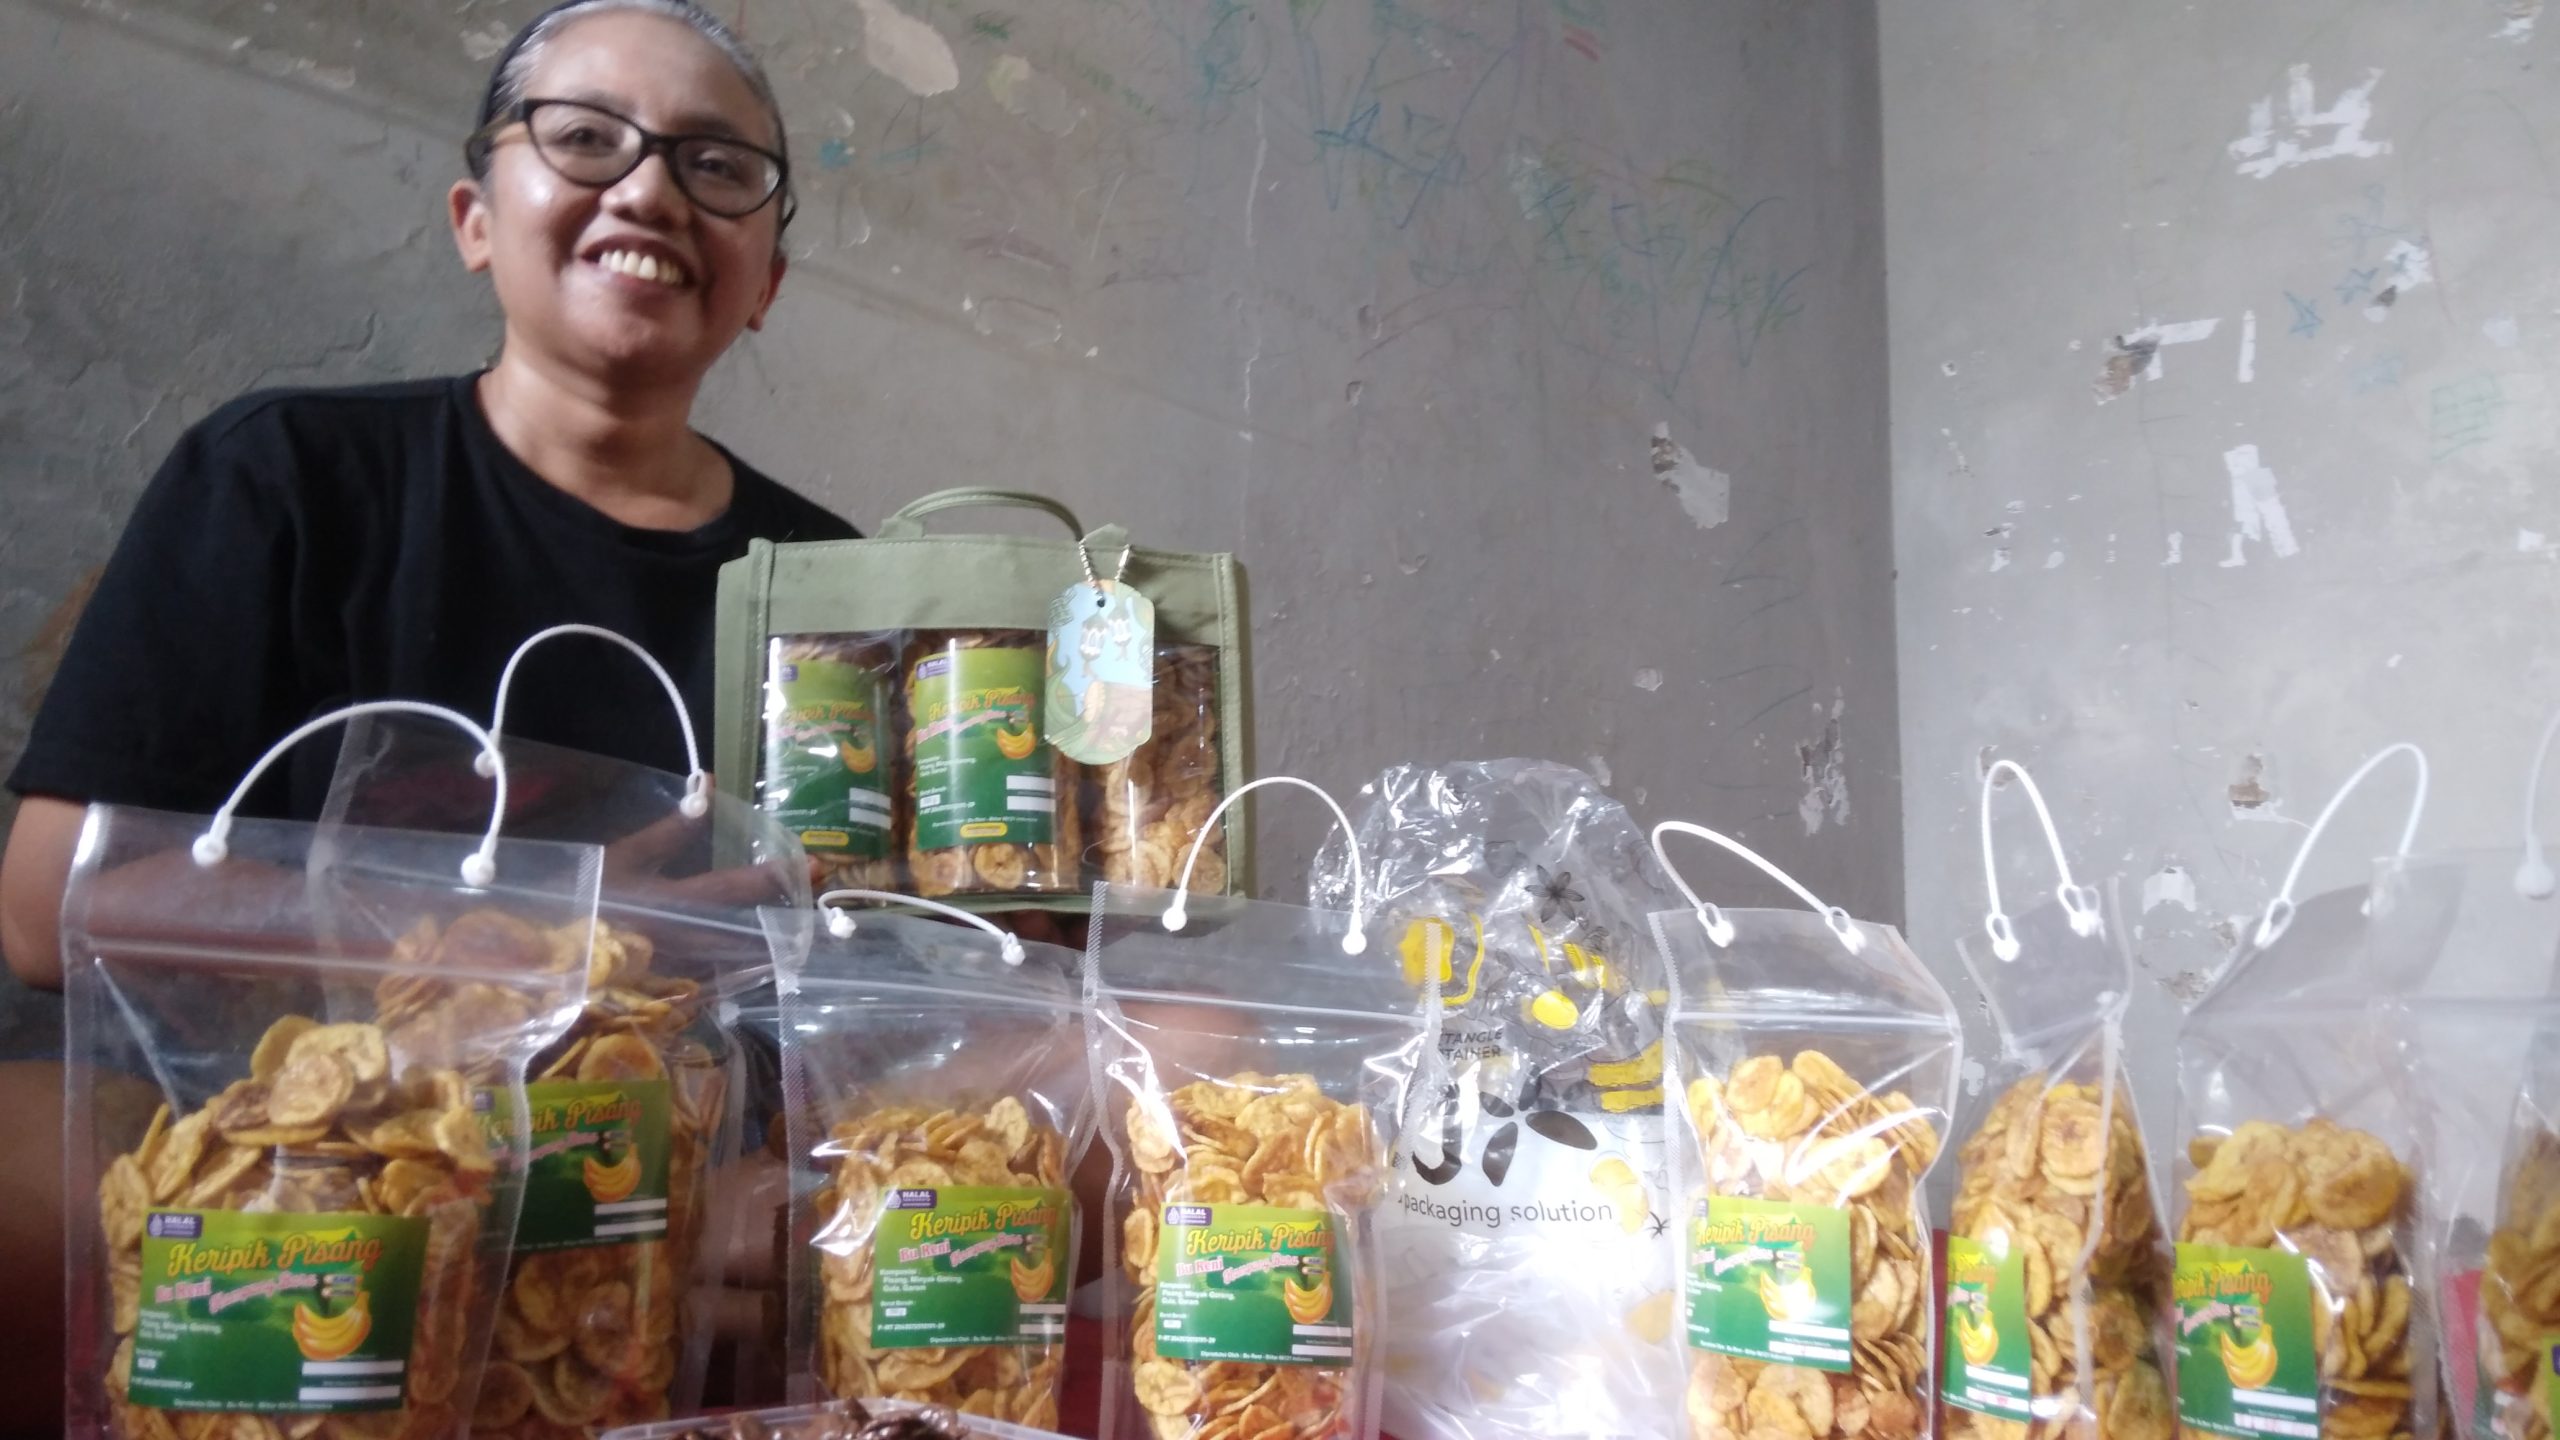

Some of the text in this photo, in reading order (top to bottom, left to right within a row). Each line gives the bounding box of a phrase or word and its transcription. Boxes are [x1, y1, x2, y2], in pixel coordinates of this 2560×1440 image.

[1441, 1028, 1504, 1044] TANGLE
[1439, 1044, 1501, 1061] TAINER
[565, 1099, 644, 1129] Pisang
[902, 1190, 931, 1199] HALAL
[910, 1208, 992, 1240] Keripik
[1404, 1193, 1613, 1229] packaging solution
[1186, 1223, 1337, 1256] Keripik Pisang
[1748, 1216, 1815, 1251] Pisang
[168, 1233, 383, 1278] Keripik Pisang
